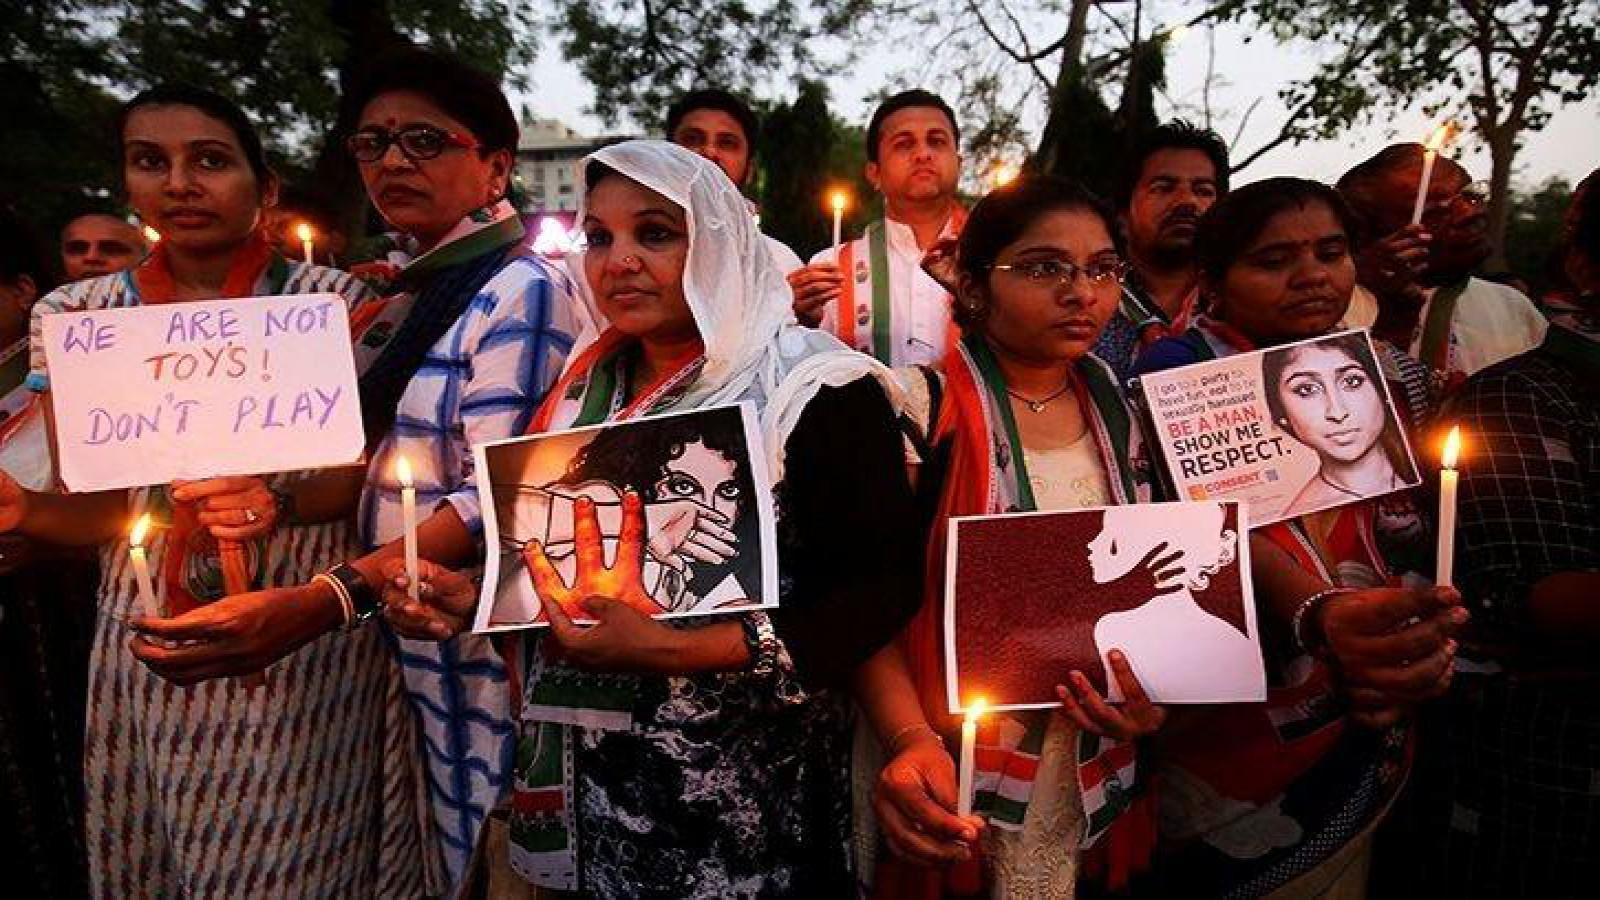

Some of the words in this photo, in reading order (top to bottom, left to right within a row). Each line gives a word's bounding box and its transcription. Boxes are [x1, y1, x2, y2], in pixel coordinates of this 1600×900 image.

[63, 317, 116, 353] WE
[167, 309, 240, 344] ARE
[265, 303, 333, 337] NOT
[1202, 372, 1230, 387] party
[84, 392, 200, 444] DON'T
[234, 385, 342, 433] PLAY
[1162, 403, 1206, 419] sexually
[1207, 391, 1256, 409] harassed
[1167, 420, 1193, 439] BE
[1199, 417, 1212, 432] A
[1213, 406, 1263, 427] MAN,
[1173, 430, 1230, 456] SHOW
[1236, 422, 1262, 440] ME
[1181, 436, 1291, 478] RESPECT.
[1205, 471, 1259, 492] CONSENT
